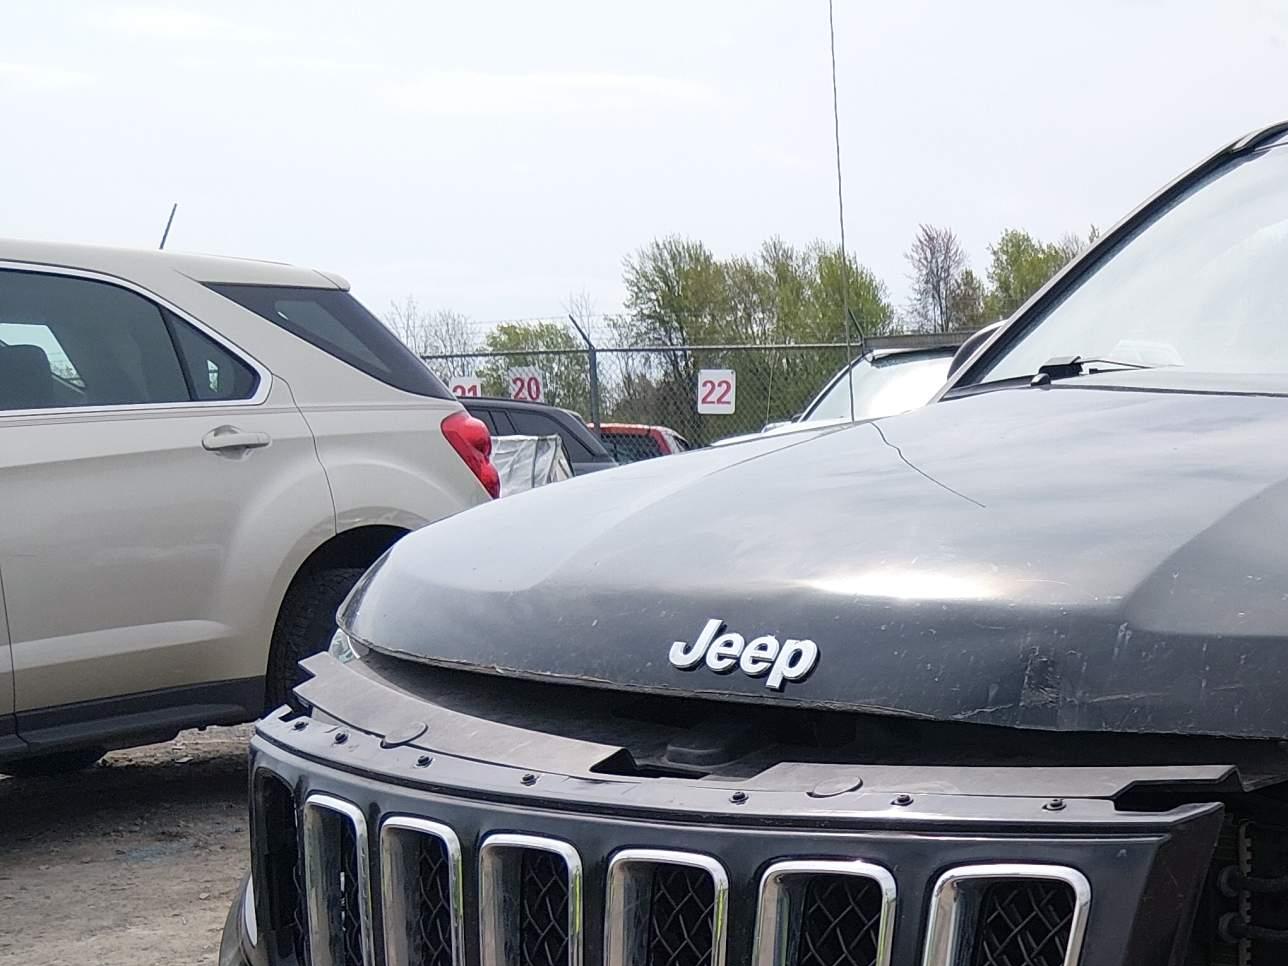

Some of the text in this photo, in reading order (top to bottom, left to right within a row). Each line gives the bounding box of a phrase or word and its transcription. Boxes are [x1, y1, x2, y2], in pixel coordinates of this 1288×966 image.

[512, 377, 541, 400] 20
[701, 380, 732, 405] 22
[668, 618, 819, 690] Jeep
